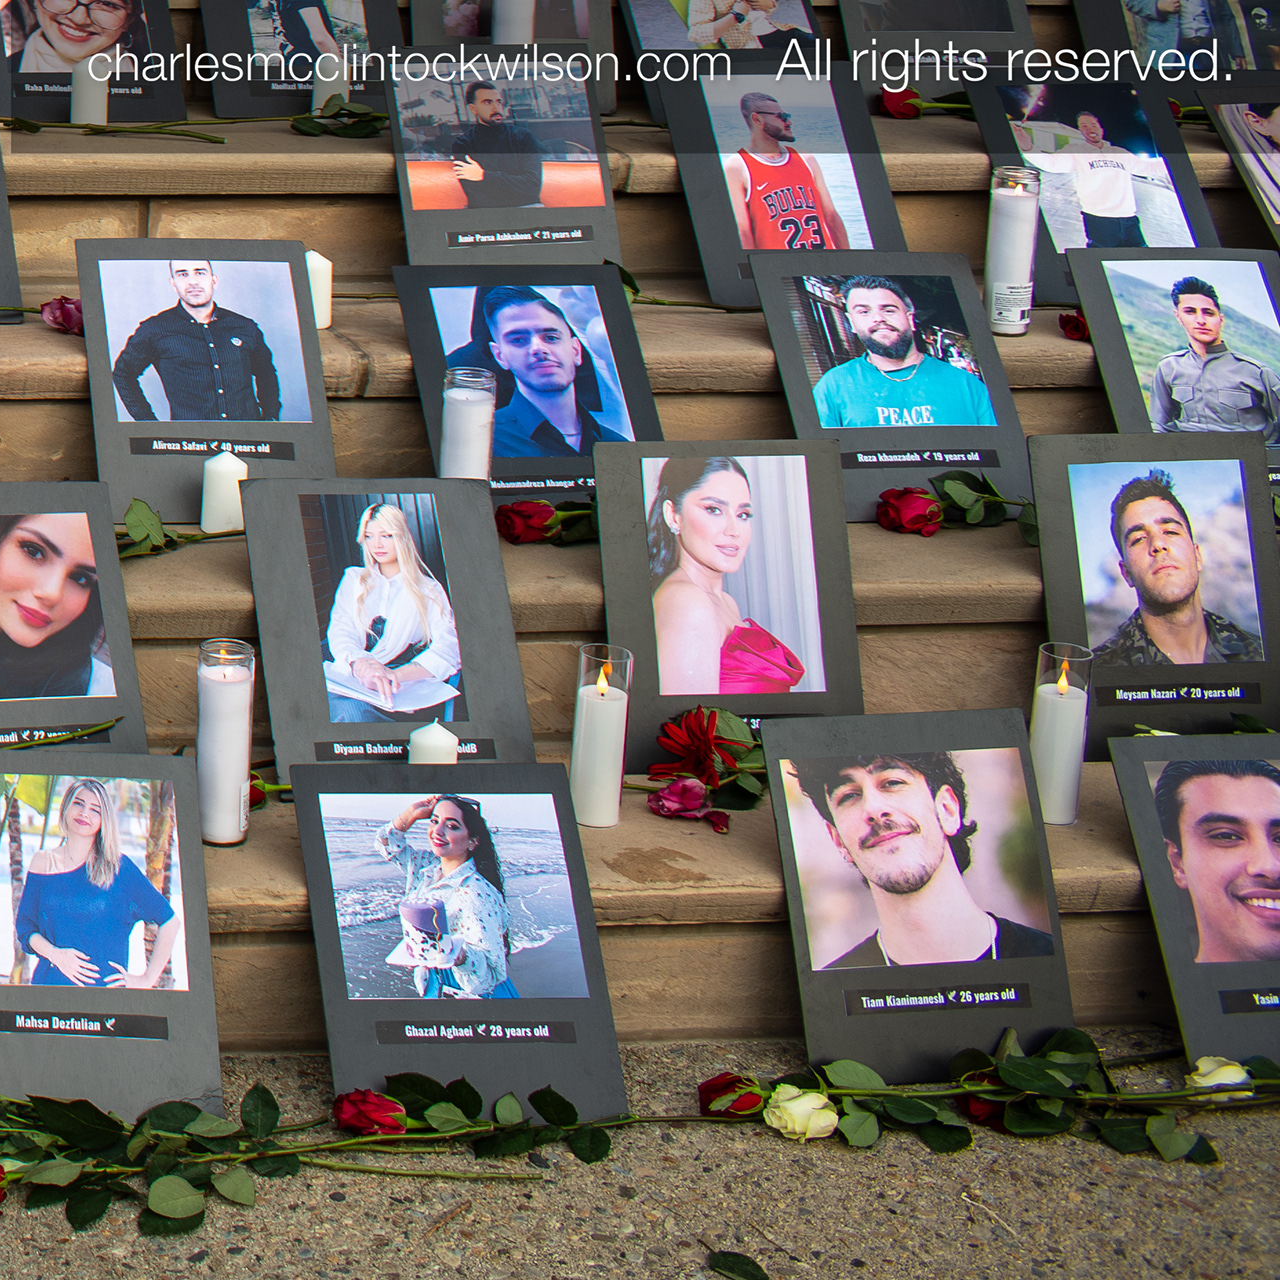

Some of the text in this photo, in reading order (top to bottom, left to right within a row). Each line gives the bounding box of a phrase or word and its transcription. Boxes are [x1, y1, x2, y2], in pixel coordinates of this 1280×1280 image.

[778, 213, 826, 250] 23
[876, 405, 935, 426] PEACE
[1115, 687, 1240, 700] Meysam Nazari 20 years old
[861, 988, 1016, 1009] Tiam Kianimanesh 26 years old
[15, 1015, 101, 1031] Mahsa Dezfulian
[404, 1024, 550, 1039] Ghazal Aghaei 28 years old
